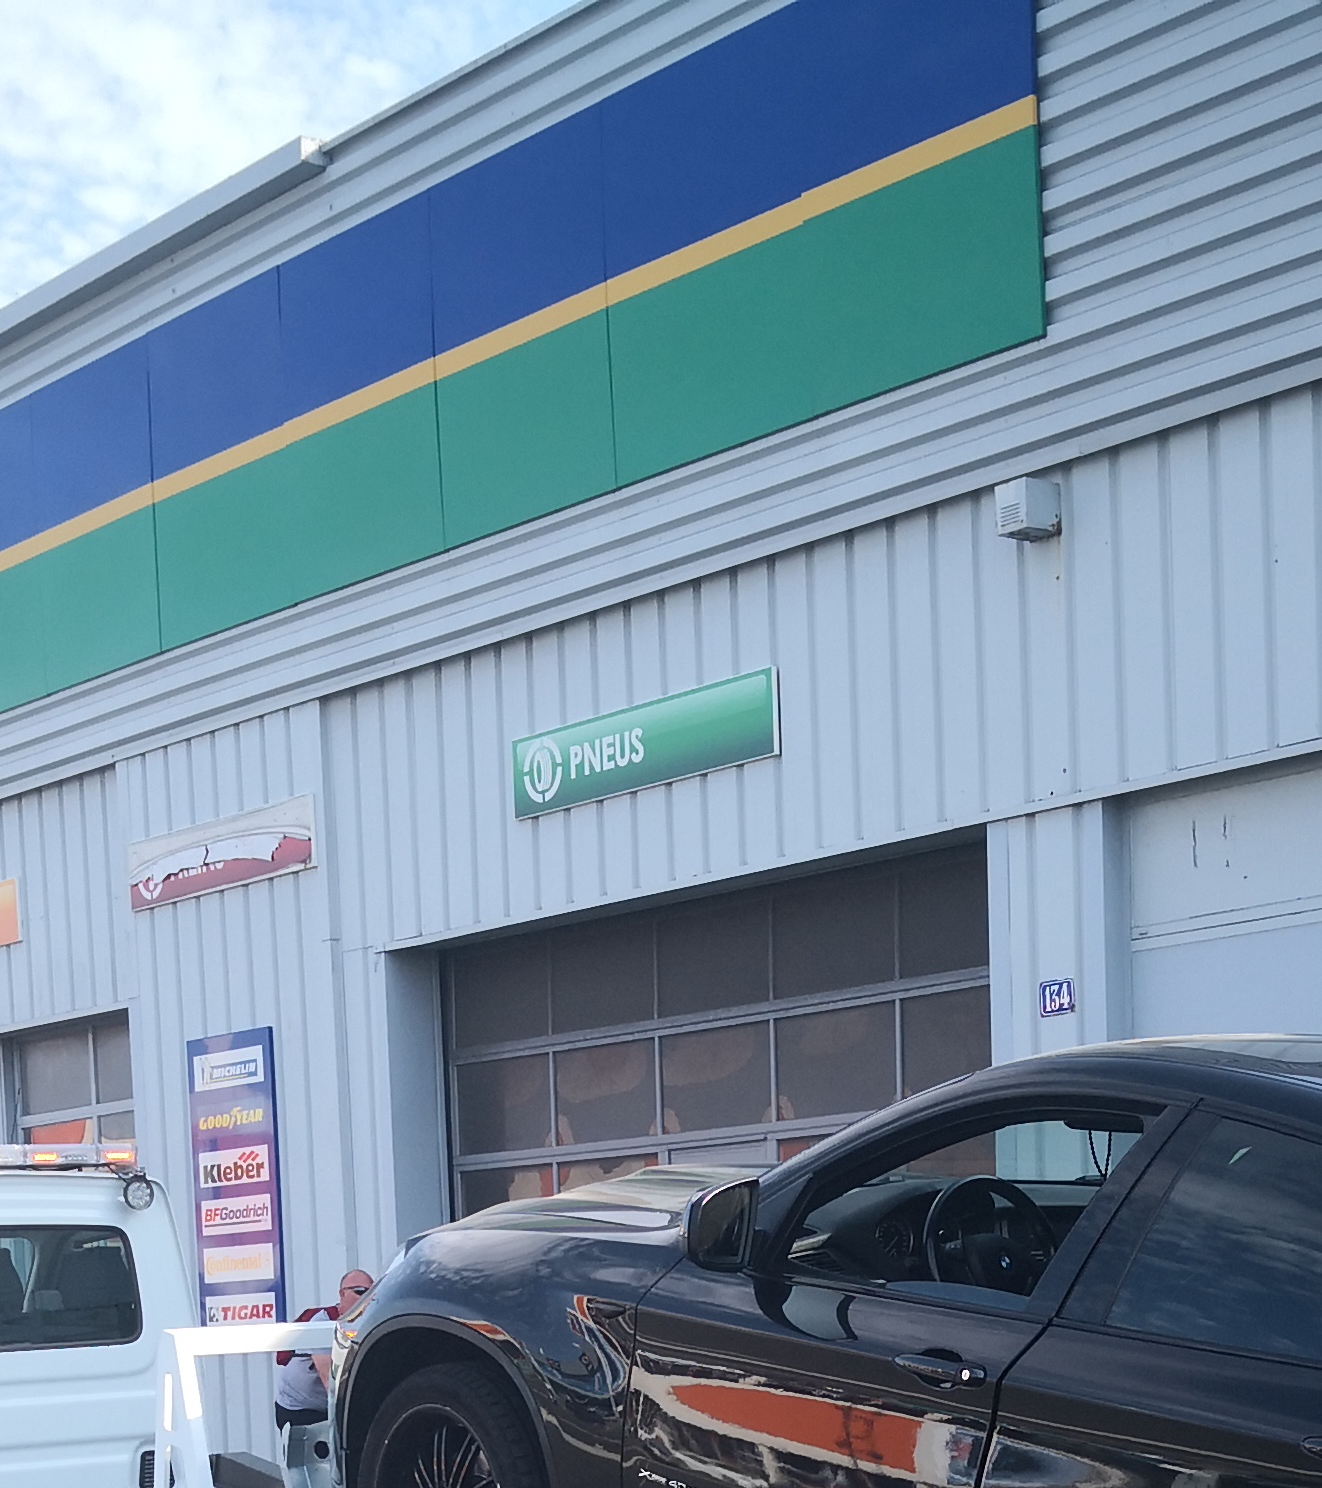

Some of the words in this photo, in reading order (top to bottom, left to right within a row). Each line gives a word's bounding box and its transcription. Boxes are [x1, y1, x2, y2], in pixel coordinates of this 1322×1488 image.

[569, 728, 645, 779] PNEUS
[1045, 982, 1071, 1012] 134
[212, 1062, 257, 1079] MICHELIN
[199, 1106, 264, 1131] GOODYEAR
[203, 1161, 265, 1185] Kleber
[204, 1202, 269, 1223] BFGoodrich
[206, 1253, 262, 1276] Continental
[221, 1303, 274, 1321] TIGAR
